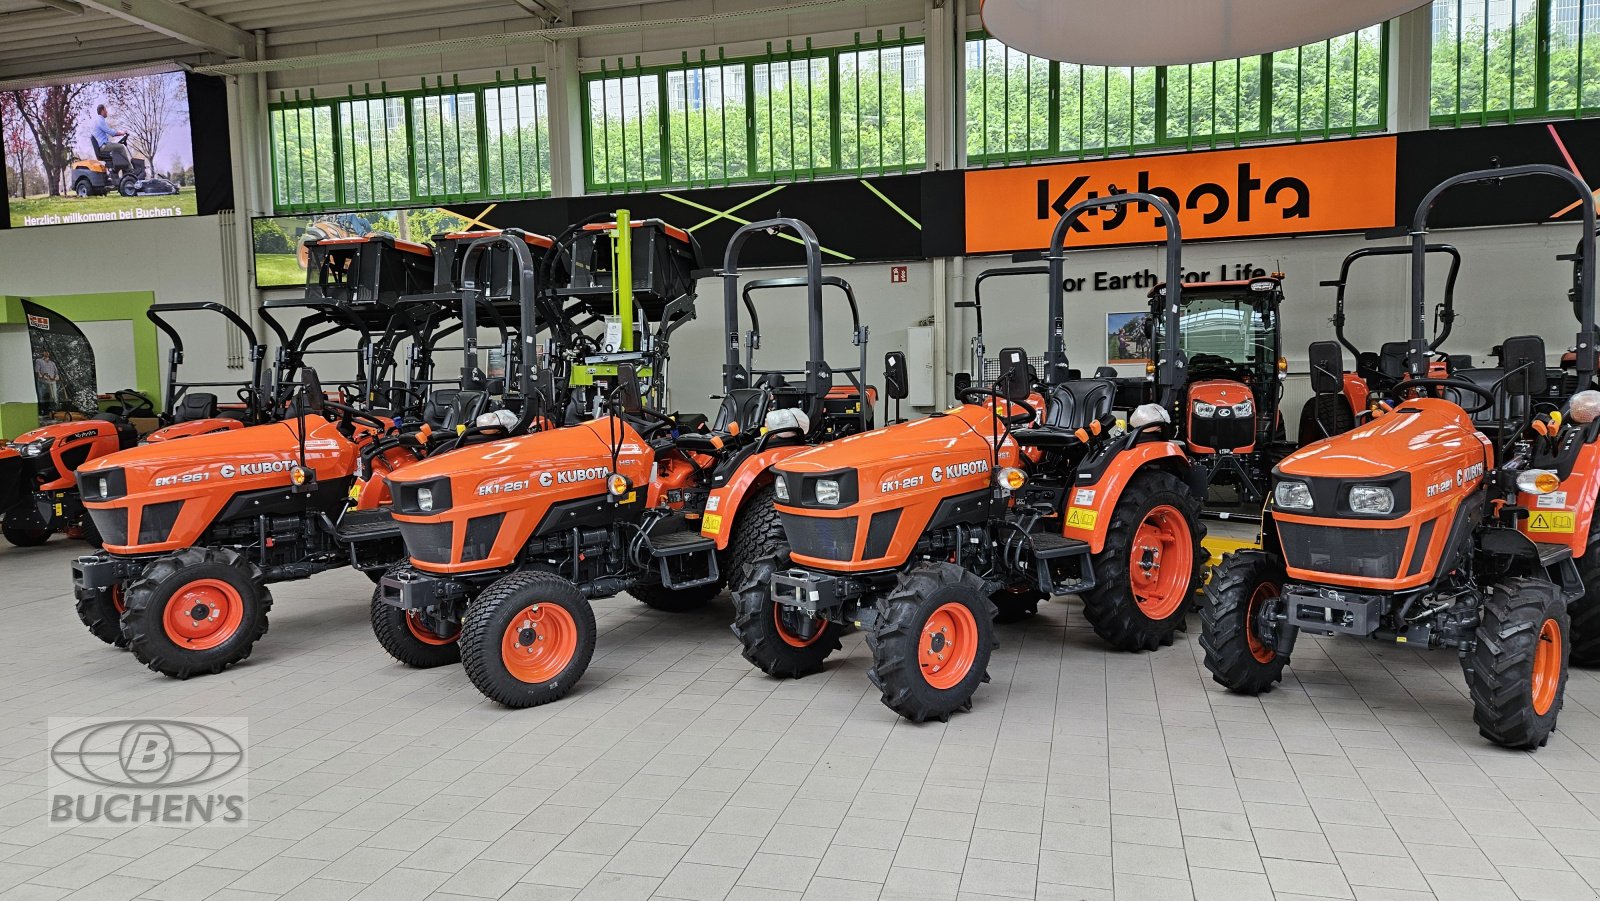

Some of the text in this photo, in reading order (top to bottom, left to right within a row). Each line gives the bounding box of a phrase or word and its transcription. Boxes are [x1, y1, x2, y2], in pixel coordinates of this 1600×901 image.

[1038, 163, 1310, 233] Kubota
[24, 214, 61, 226] Herzlich
[63, 212, 117, 223] willkommen
[119, 209, 133, 219] bei
[1063, 276, 1086, 293] or
[1094, 269, 1158, 291] Earth
[1221, 263, 1266, 281] Life
[155, 472, 209, 487] EK1-261
[478, 466, 609, 496] EK1-261 KUBOTA
[881, 459, 989, 493] EK1-261 KUBOTA
